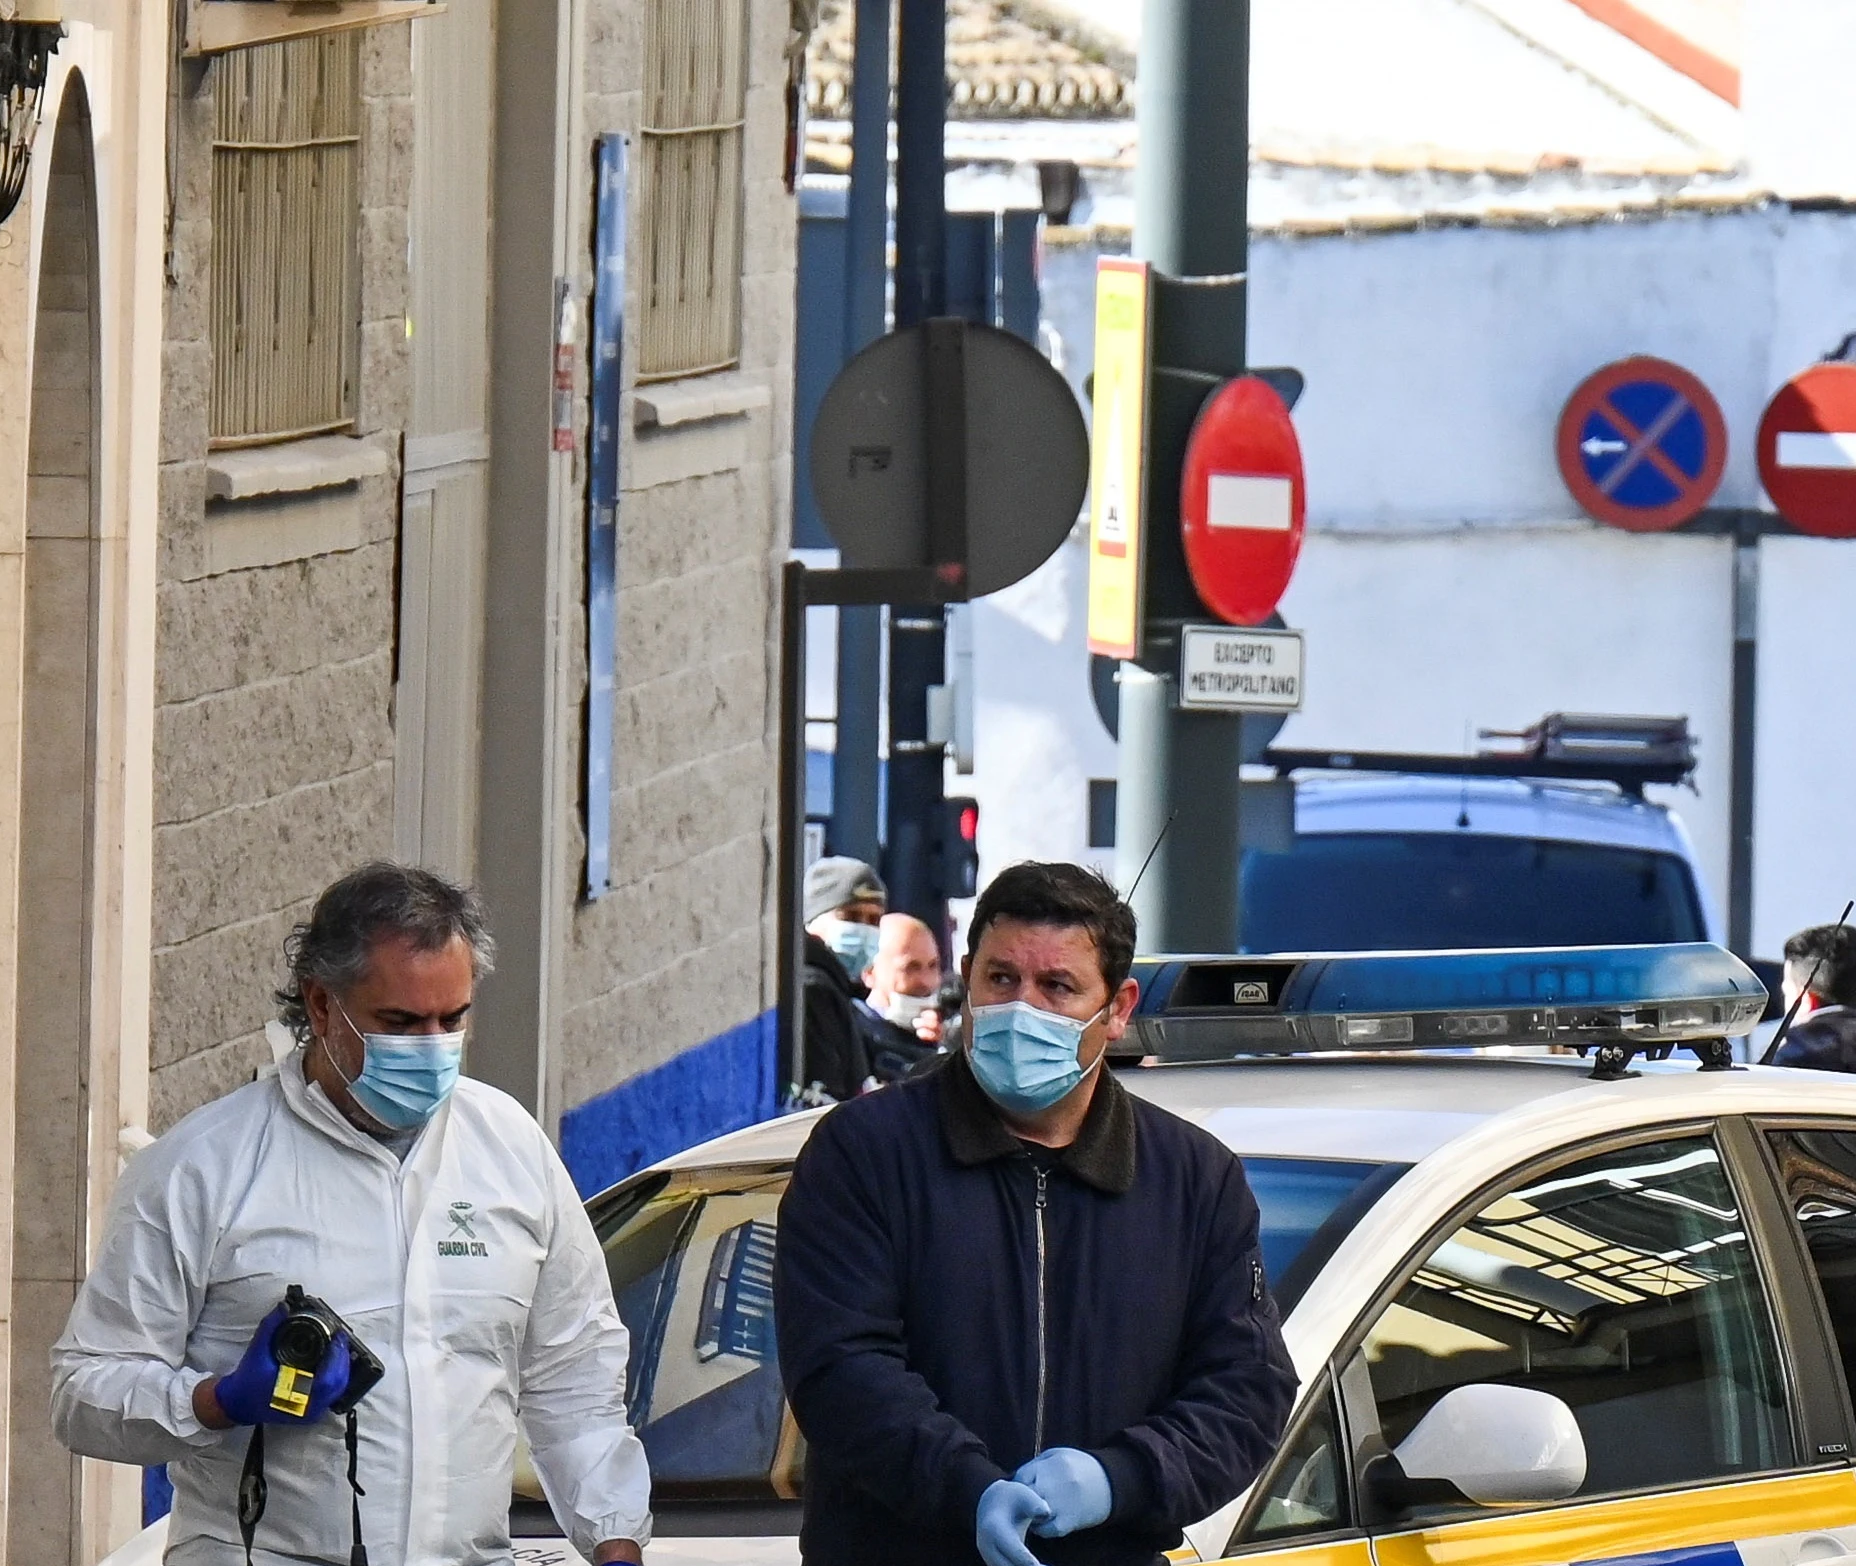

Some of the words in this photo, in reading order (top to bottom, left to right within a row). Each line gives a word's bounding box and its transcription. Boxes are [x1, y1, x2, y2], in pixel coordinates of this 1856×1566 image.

[1214, 642, 1272, 663] EXCEPTO
[438, 1241, 469, 1256] GUARDIA
[471, 1242, 488, 1257] CIVIL
